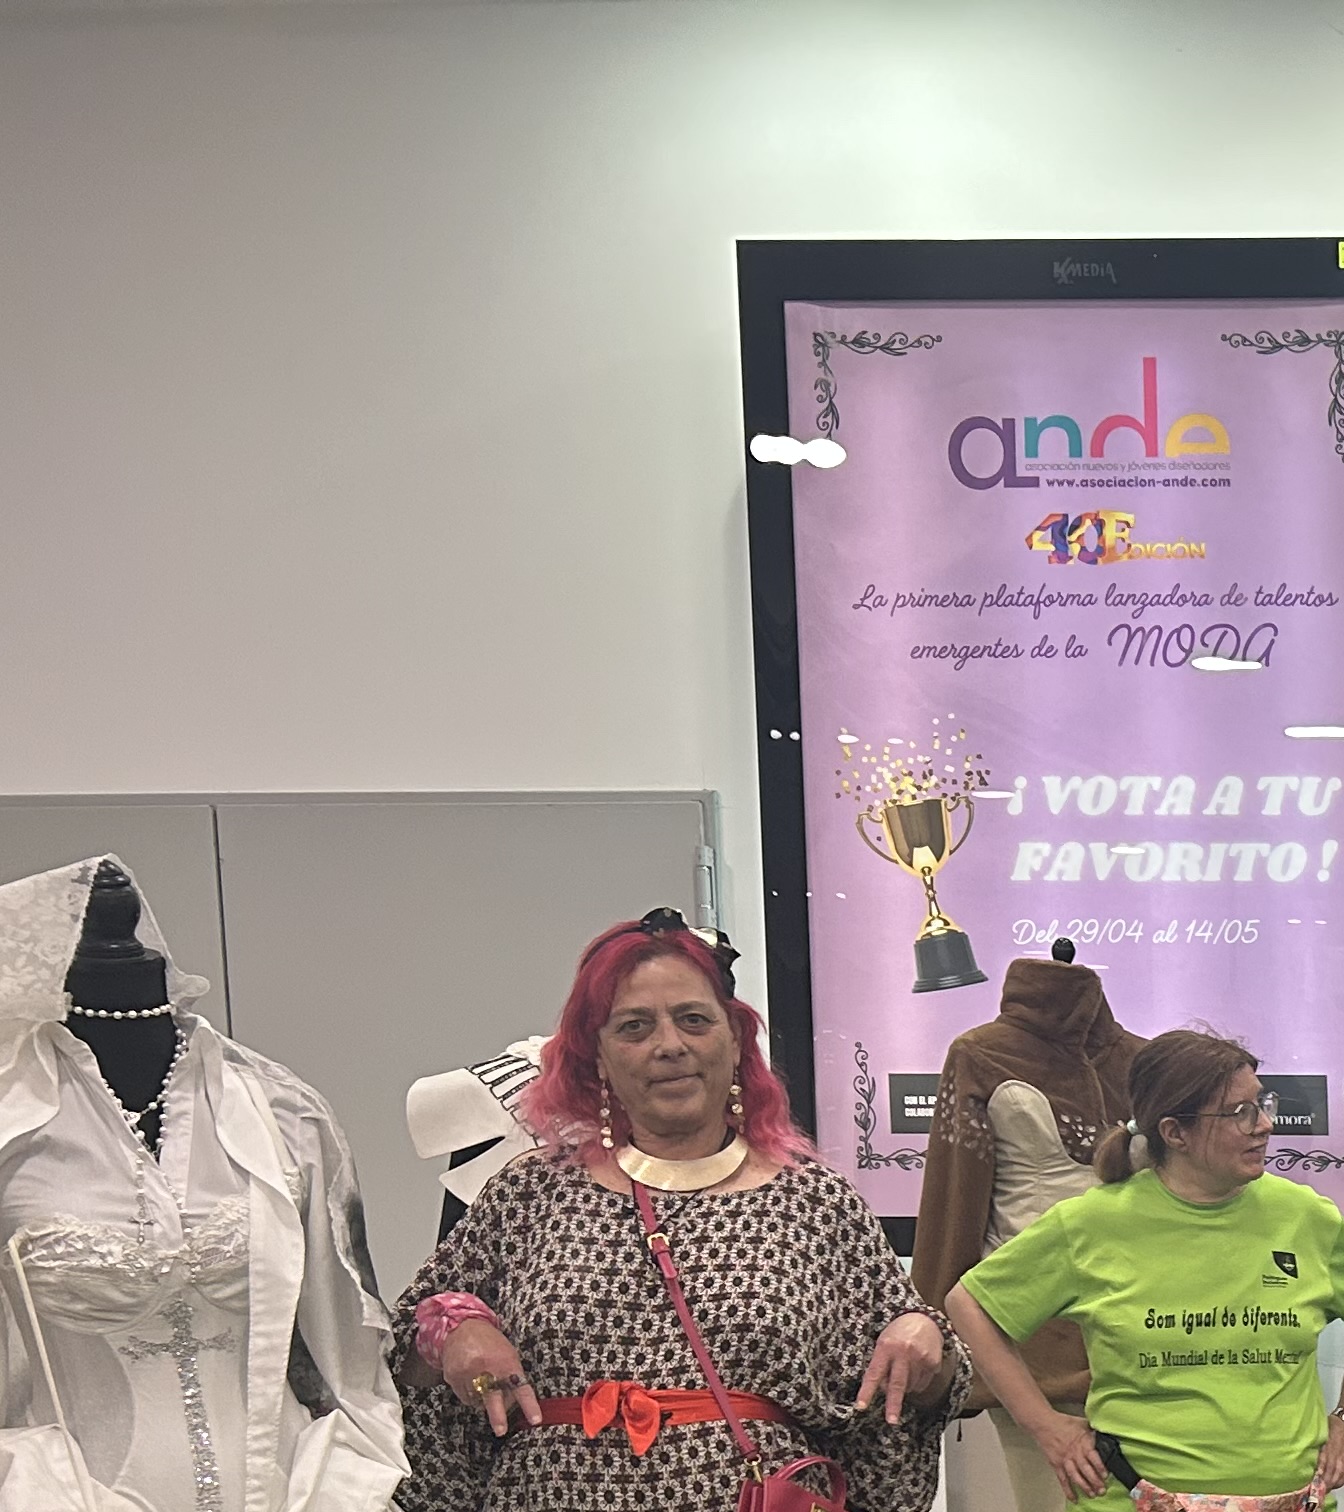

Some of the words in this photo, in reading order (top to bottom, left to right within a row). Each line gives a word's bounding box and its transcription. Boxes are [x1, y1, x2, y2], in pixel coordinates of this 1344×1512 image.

[948, 357, 1231, 490] ande
[1046, 475, 1231, 488] www.asociacion-ande.com
[852, 583, 888, 611] La
[891, 588, 976, 618] primera
[978, 583, 1098, 622] plataforma
[1104, 583, 1213, 625] lanzadora
[1220, 583, 1248, 609] de
[1253, 583, 1339, 610] talentos
[910, 640, 1025, 672] emergentes
[1031, 636, 1058, 659] de
[1065, 636, 1088, 659] la
[1107, 622, 1280, 669] MODA
[1041, 775, 1199, 816] VOTA
[1201, 775, 1249, 816] A
[1257, 775, 1342, 816] TU
[1010, 841, 1309, 882] FAVORITO
[1012, 919, 1057, 945] Del
[1065, 919, 1144, 945] 29/04
[1152, 919, 1178, 944] al
[1185, 919, 1260, 945] 14/05
[1144, 1308, 1175, 1330] Som
[1182, 1306, 1217, 1335] igual
[1221, 1306, 1236, 1327] de
[1139, 1352, 1158, 1369] Dia
[1162, 1349, 1208, 1367] Mundial
[1211, 1350, 1224, 1365] de
[1227, 1349, 1239, 1365] la
[1242, 1348, 1272, 1364] Salut
